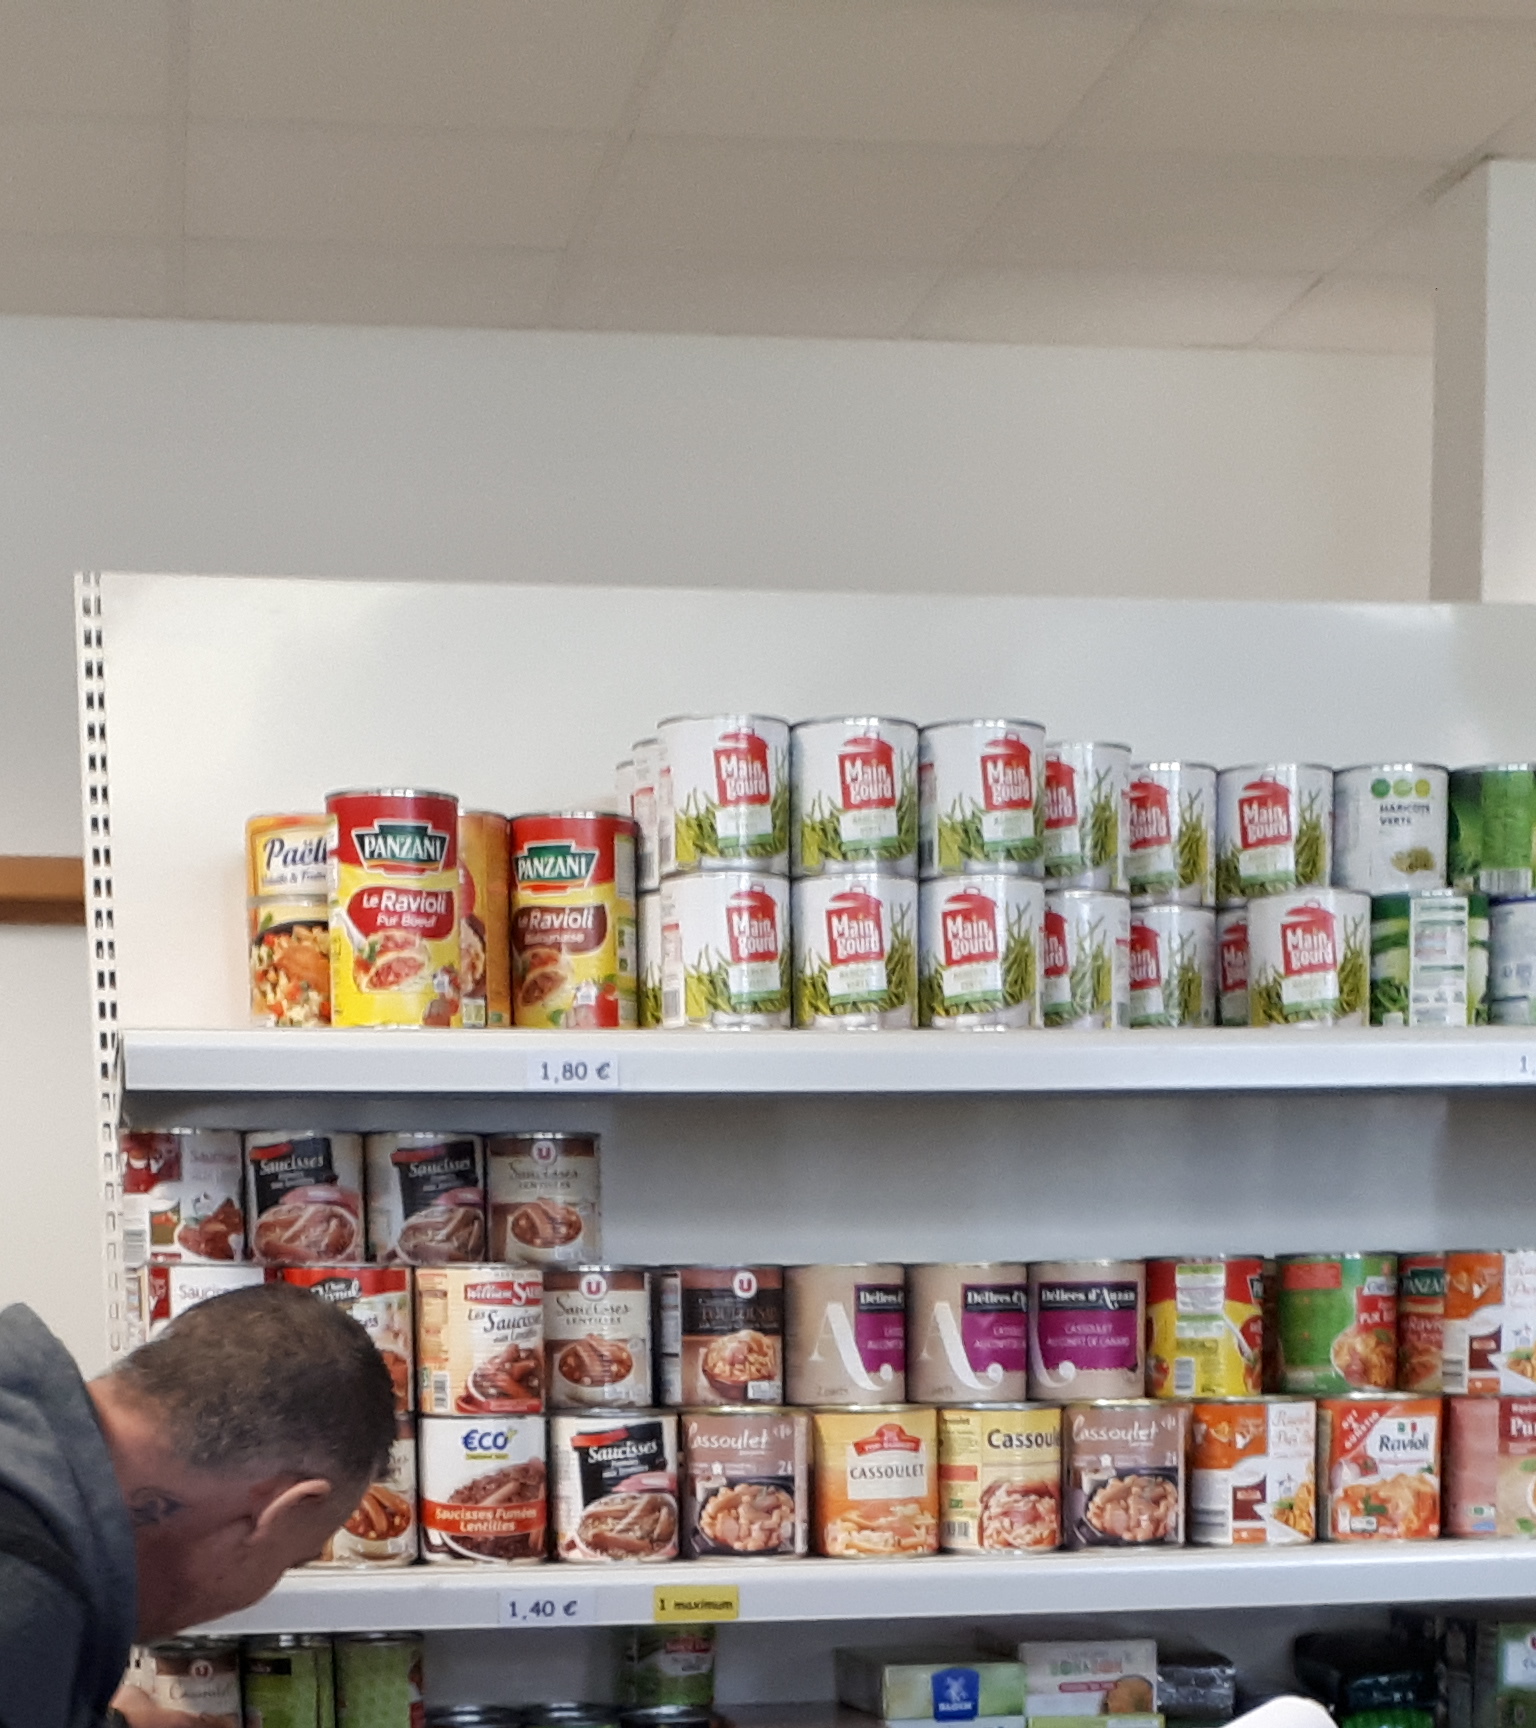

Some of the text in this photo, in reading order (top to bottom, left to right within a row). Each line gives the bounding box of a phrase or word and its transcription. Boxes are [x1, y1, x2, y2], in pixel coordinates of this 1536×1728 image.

[720, 755, 762, 779] Main
[845, 758, 887, 782] Main
[987, 760, 1026, 783] Main
[1243, 800, 1283, 824] Main
[264, 837, 328, 870] Paëll
[364, 833, 442, 861] PANZANI
[517, 854, 588, 880] PANZANI
[362, 889, 447, 914] Le Ravioli
[376, 913, 398, 926] Pur
[529, 908, 595, 931] Ravioli
[732, 912, 771, 937] Main
[832, 915, 874, 939] Main
[947, 914, 989, 938] Main
[1287, 929, 1329, 952] Main
[541, 1061, 611, 1084] 1,80 €
[259, 1154, 324, 1176] Saucisses
[537, 1147, 552, 1160] U
[408, 1157, 472, 1178] Saucisses
[586, 1279, 602, 1296] U
[739, 1277, 753, 1293] U
[1401, 1276, 1445, 1295] ANZA
[467, 1307, 543, 1333] Les Saucisse
[687, 1421, 769, 1450] Cassoulet
[1072, 1413, 1160, 1447] Cassoulet
[587, 1439, 658, 1465] Saucisses
[1378, 1434, 1431, 1452] Ravioli
[849, 1464, 925, 1480] CASSOULET
[434, 1506, 537, 1520] Saucisses Fumées
[459, 1519, 516, 1533] Lentilles
[509, 1600, 579, 1620] 1,40 €
[673, 1600, 733, 1611] maximum
[196, 1665, 209, 1678] U
[938, 1701, 974, 1713] BLOCH
